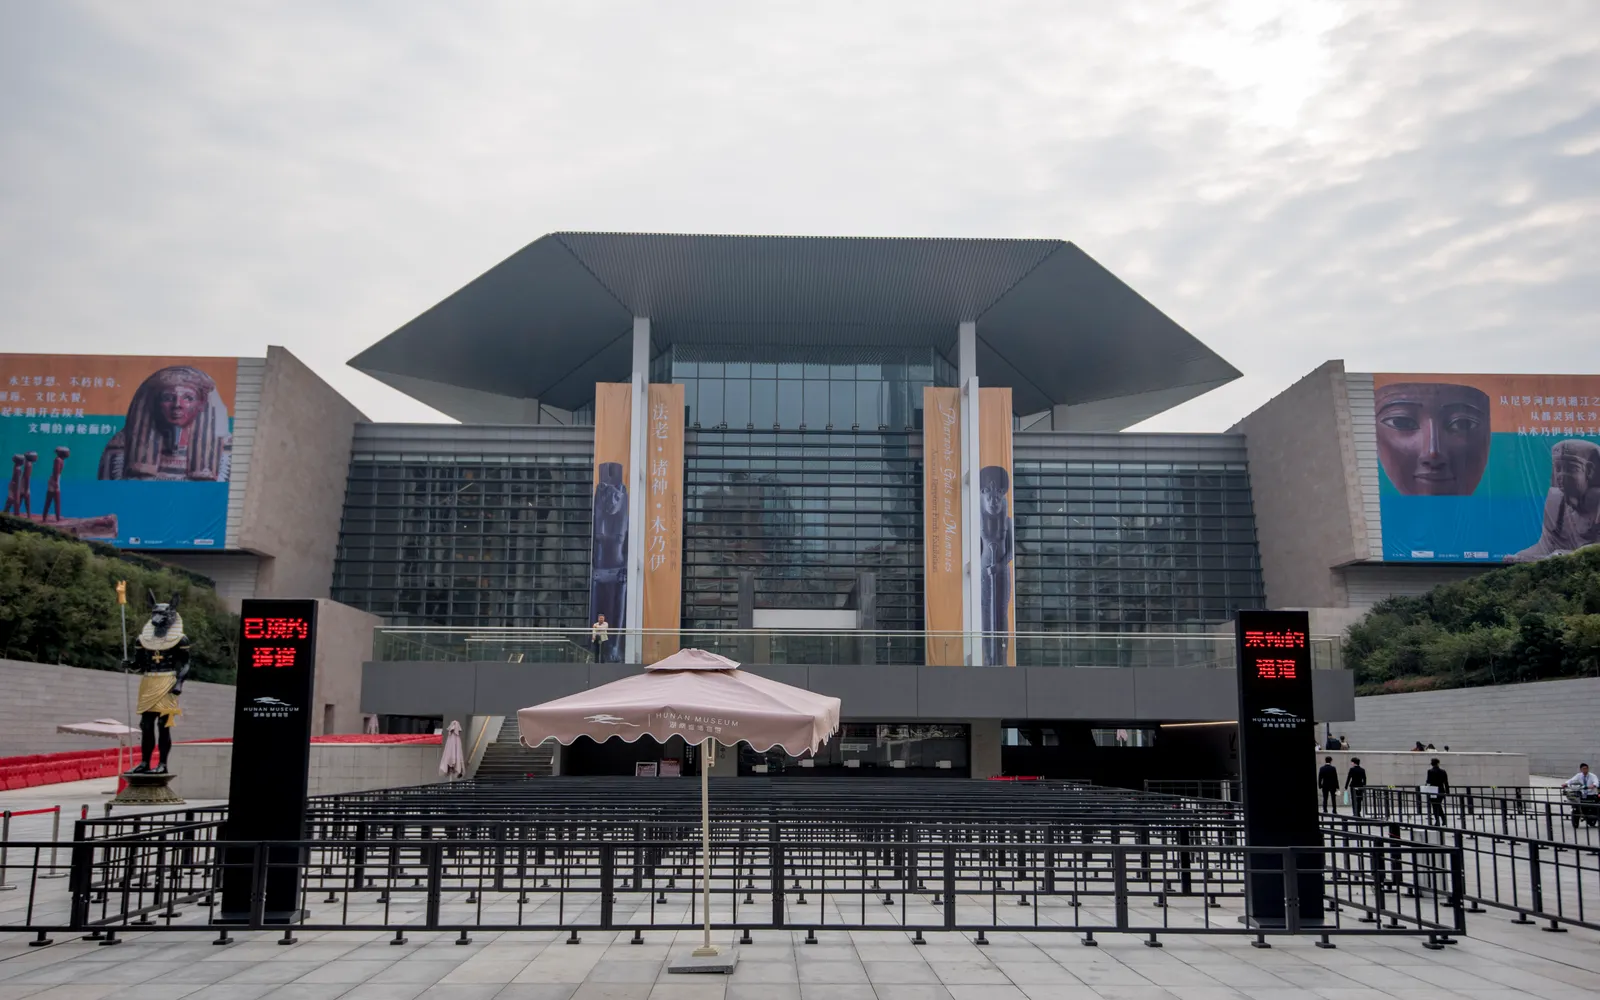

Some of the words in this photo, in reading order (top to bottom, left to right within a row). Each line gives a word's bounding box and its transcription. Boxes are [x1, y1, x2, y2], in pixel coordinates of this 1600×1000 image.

[1517, 425, 1600, 437] 从木乃伊到马王
[940, 467, 956, 494] Gods
[944, 498, 954, 516] and
[942, 516, 957, 573] Mummies
[655, 712, 691, 721] HUNAN
[694, 716, 739, 727] MUSEUM
